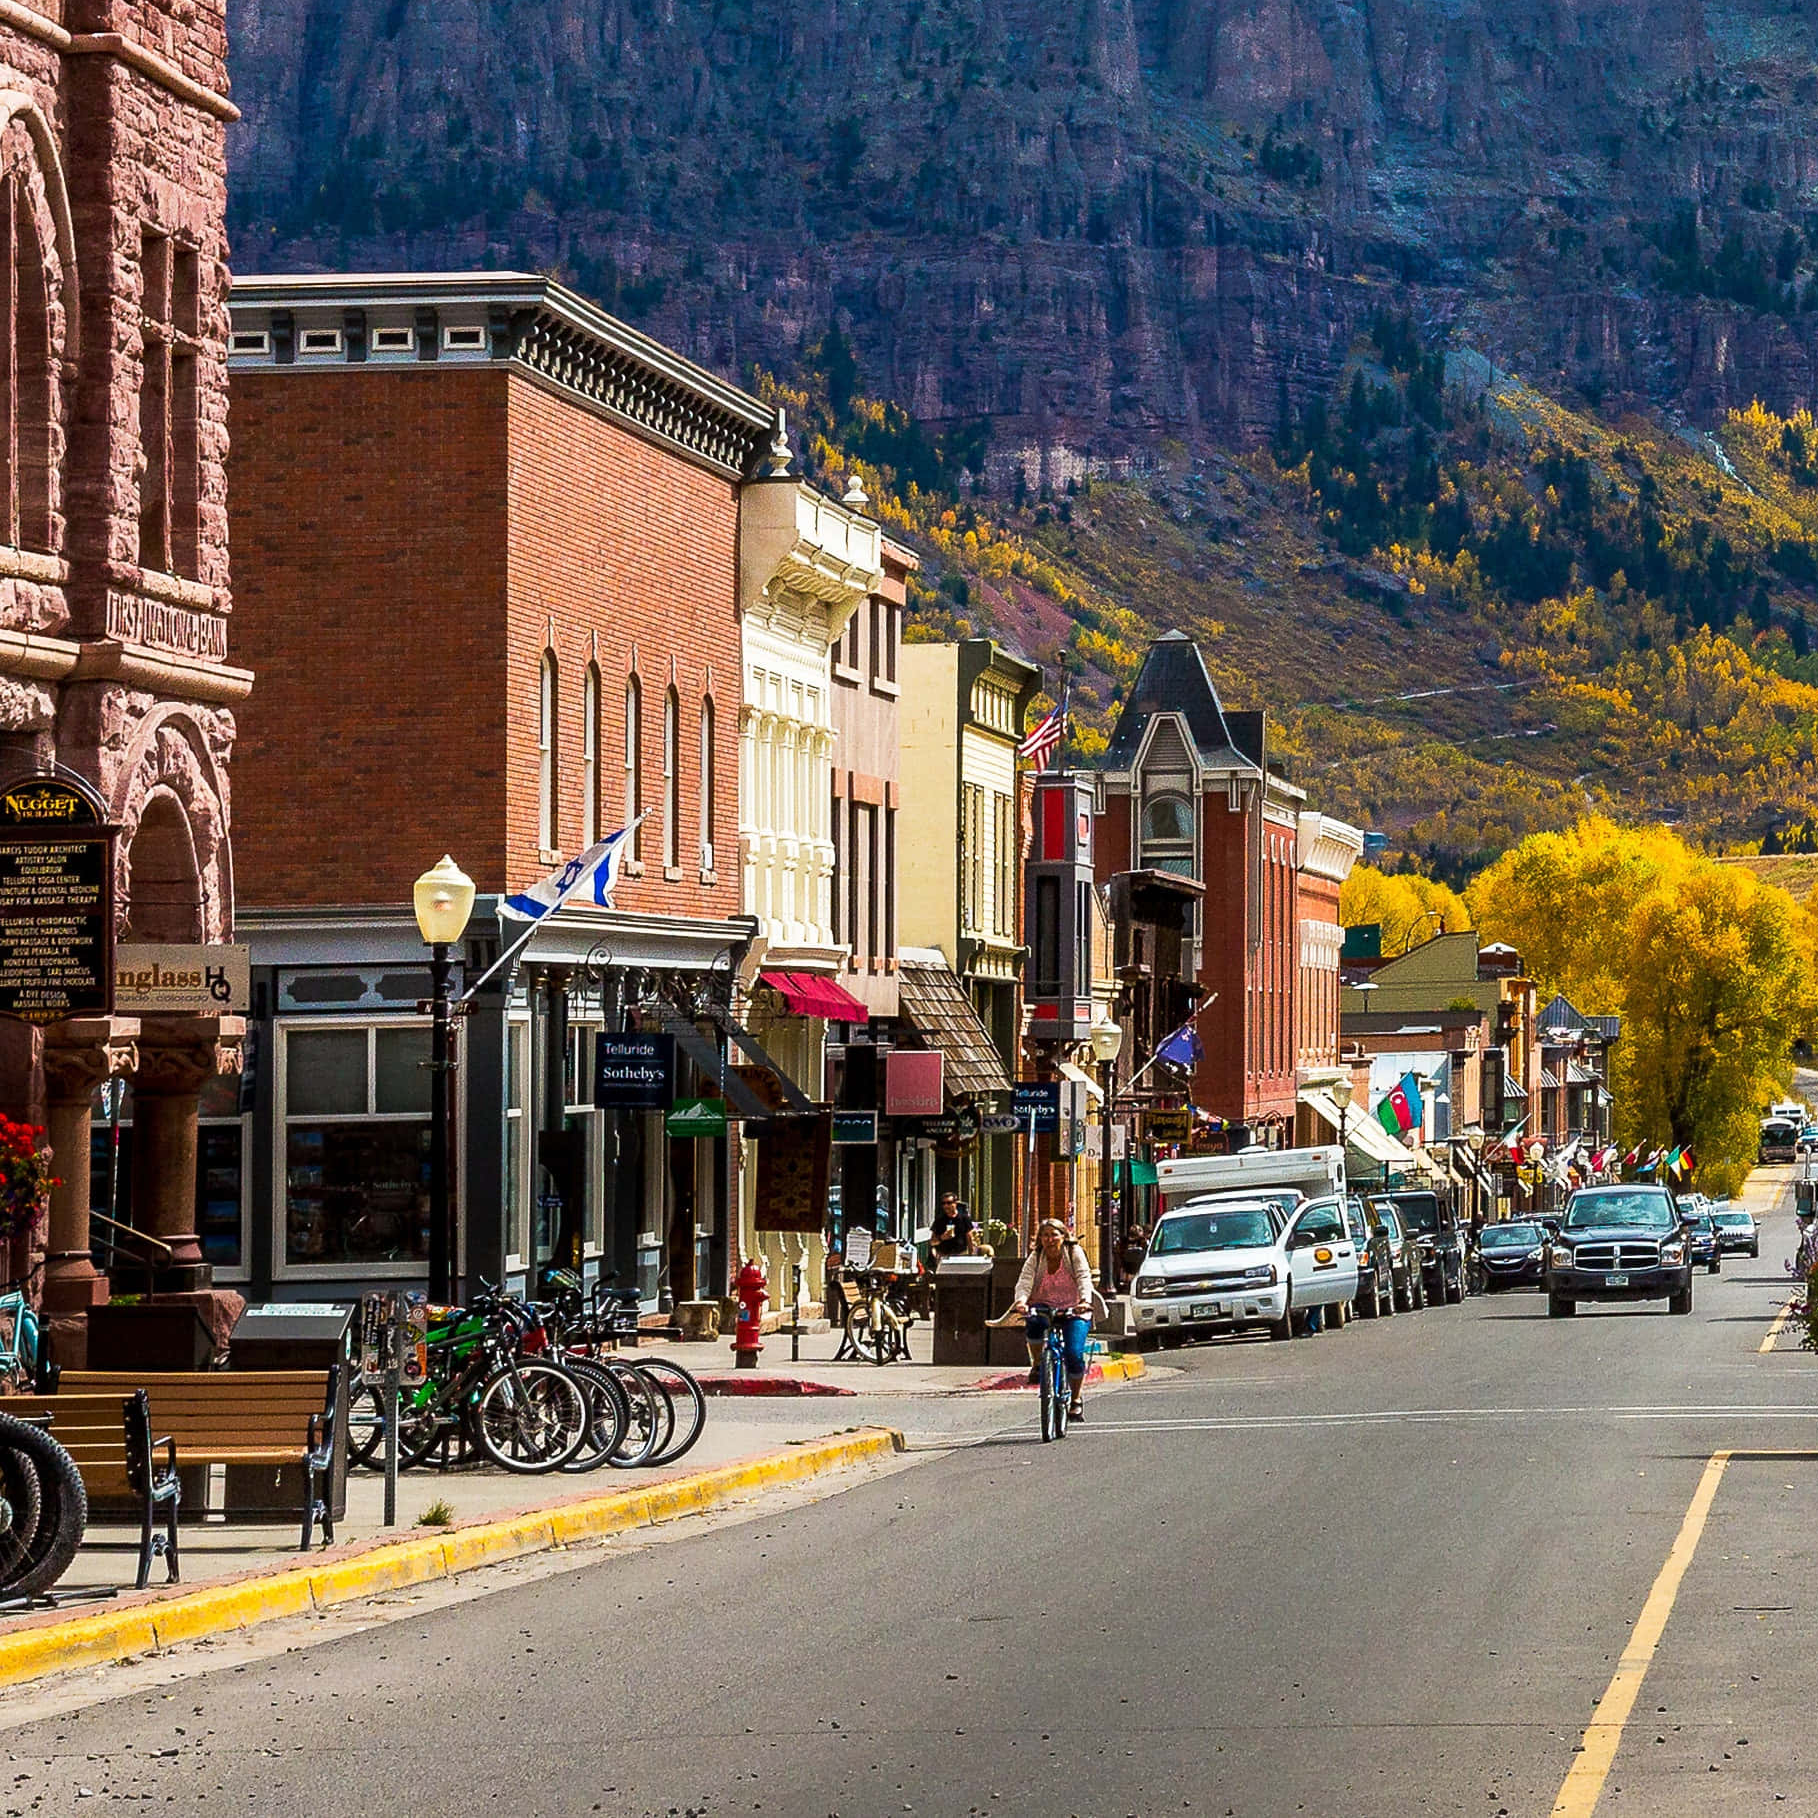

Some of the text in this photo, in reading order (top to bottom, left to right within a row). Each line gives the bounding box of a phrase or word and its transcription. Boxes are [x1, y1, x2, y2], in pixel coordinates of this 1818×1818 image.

[110, 592, 226, 656] FIRST NATIONAL BANK
[5, 795, 79, 815] NUGGET
[49, 845, 87, 854] ARCHITECT
[15, 855, 67, 864] ARTISTRY SALON
[21, 866, 63, 874] EQUILIBRIUM
[3, 877, 36, 885] TELLURIDE
[56, 875, 81, 883] CENTER
[70, 885, 99, 893] MEDICINE
[34, 896, 65, 904] MASSAGE
[36, 916, 87, 925] CHIROPRACTIC
[63, 977, 96, 985] CHOCOLATE
[41, 990, 67, 999] DESIGN
[12, 999, 71, 1008] MASSAGE WORKS
[604, 1043, 655, 1055] Telluride
[603, 1066, 665, 1082] Sotheby's
